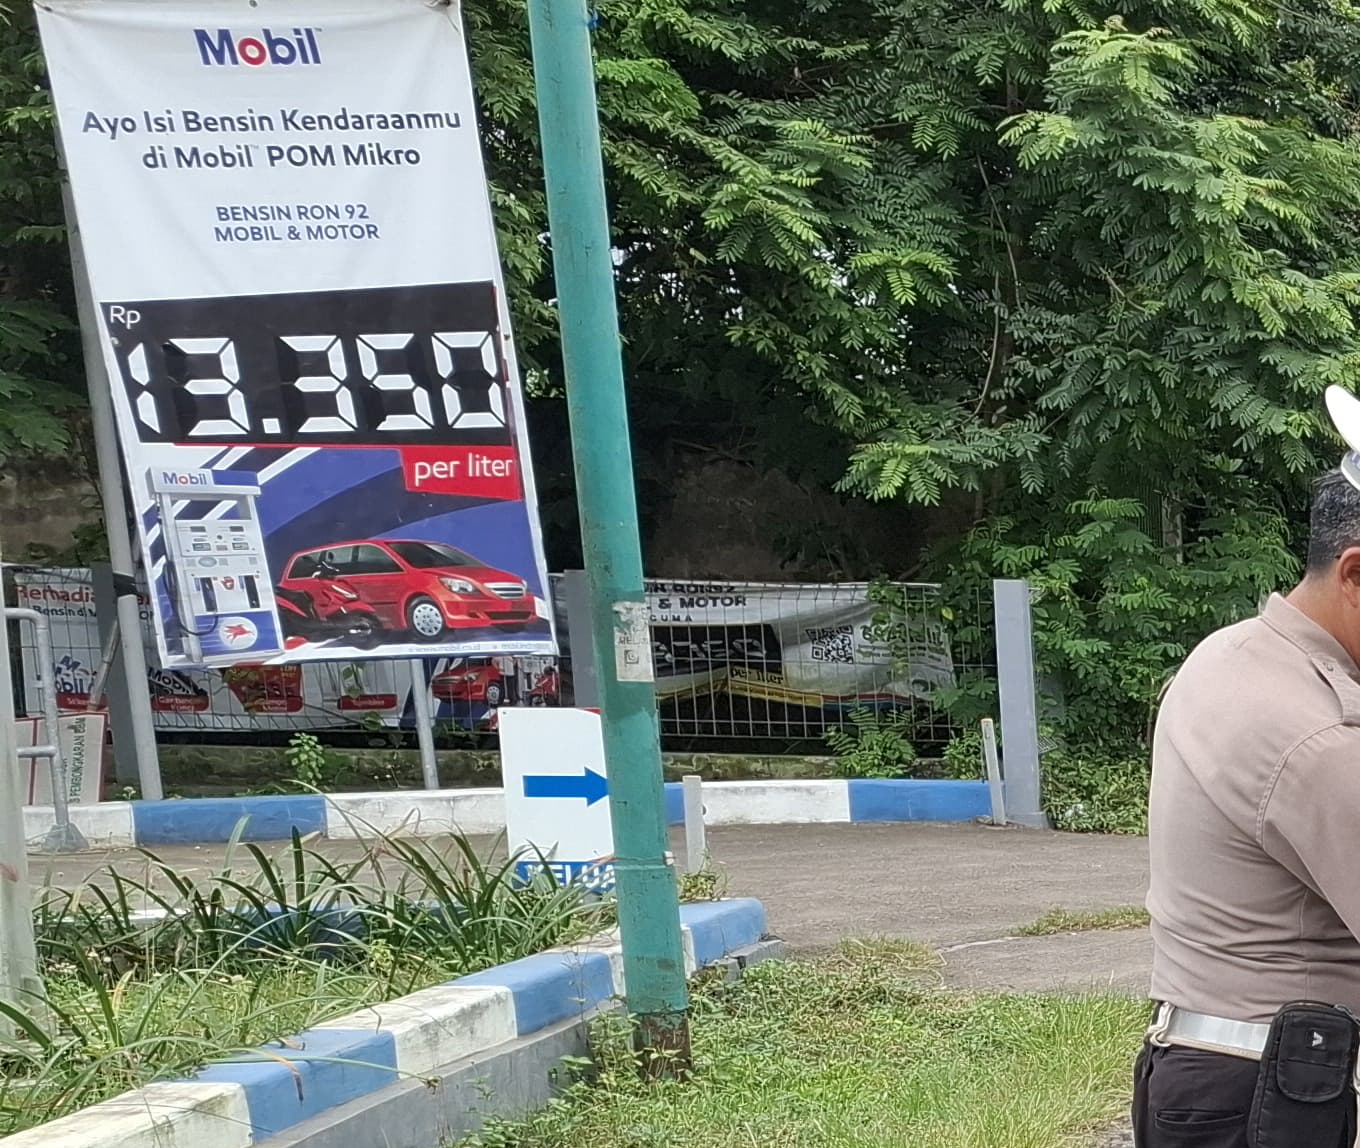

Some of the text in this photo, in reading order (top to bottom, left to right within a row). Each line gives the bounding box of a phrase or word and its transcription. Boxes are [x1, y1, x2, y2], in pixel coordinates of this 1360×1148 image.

[83, 107, 461, 140] Ayo Isi Bensin Kendaraanmu
[142, 145, 168, 168] di
[266, 145, 336, 167] POM
[342, 143, 421, 167] Mikro
[216, 203, 370, 221] BENSIN RON 92
[214, 223, 380, 241] MOBIL & MOTOR
[110, 305, 141, 330] Rp
[127, 331, 506, 435] 13.350
[162, 471, 207, 486] Mobil
[414, 452, 513, 488] per liter
[16, 584, 95, 603] Berhadi
[658, 595, 747, 610] & MOTOR
